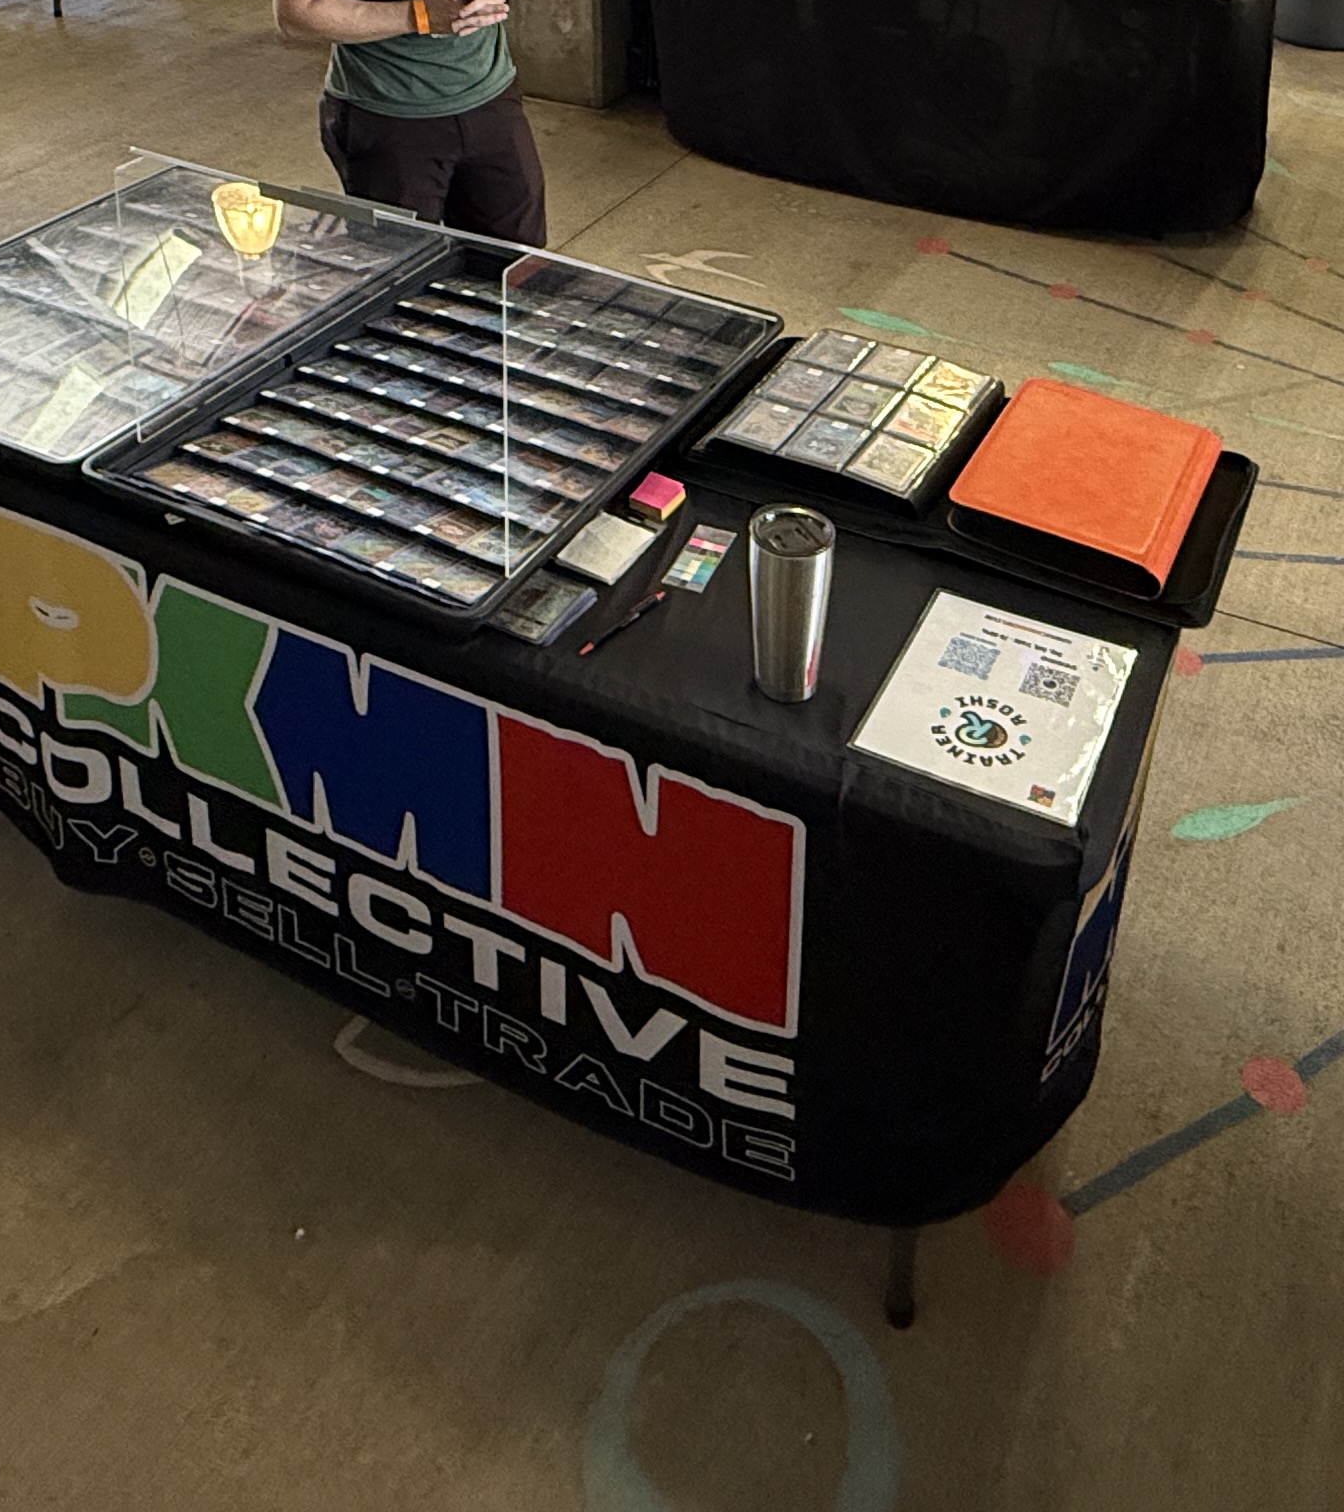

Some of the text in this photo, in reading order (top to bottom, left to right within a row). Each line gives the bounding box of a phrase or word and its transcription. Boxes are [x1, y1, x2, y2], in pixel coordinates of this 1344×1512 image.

[954, 694, 1028, 727] ROSHI
[931, 724, 1026, 768] TRAINER
[165, 854, 394, 1000] SELL
[413, 971, 797, 1182] TRADE
